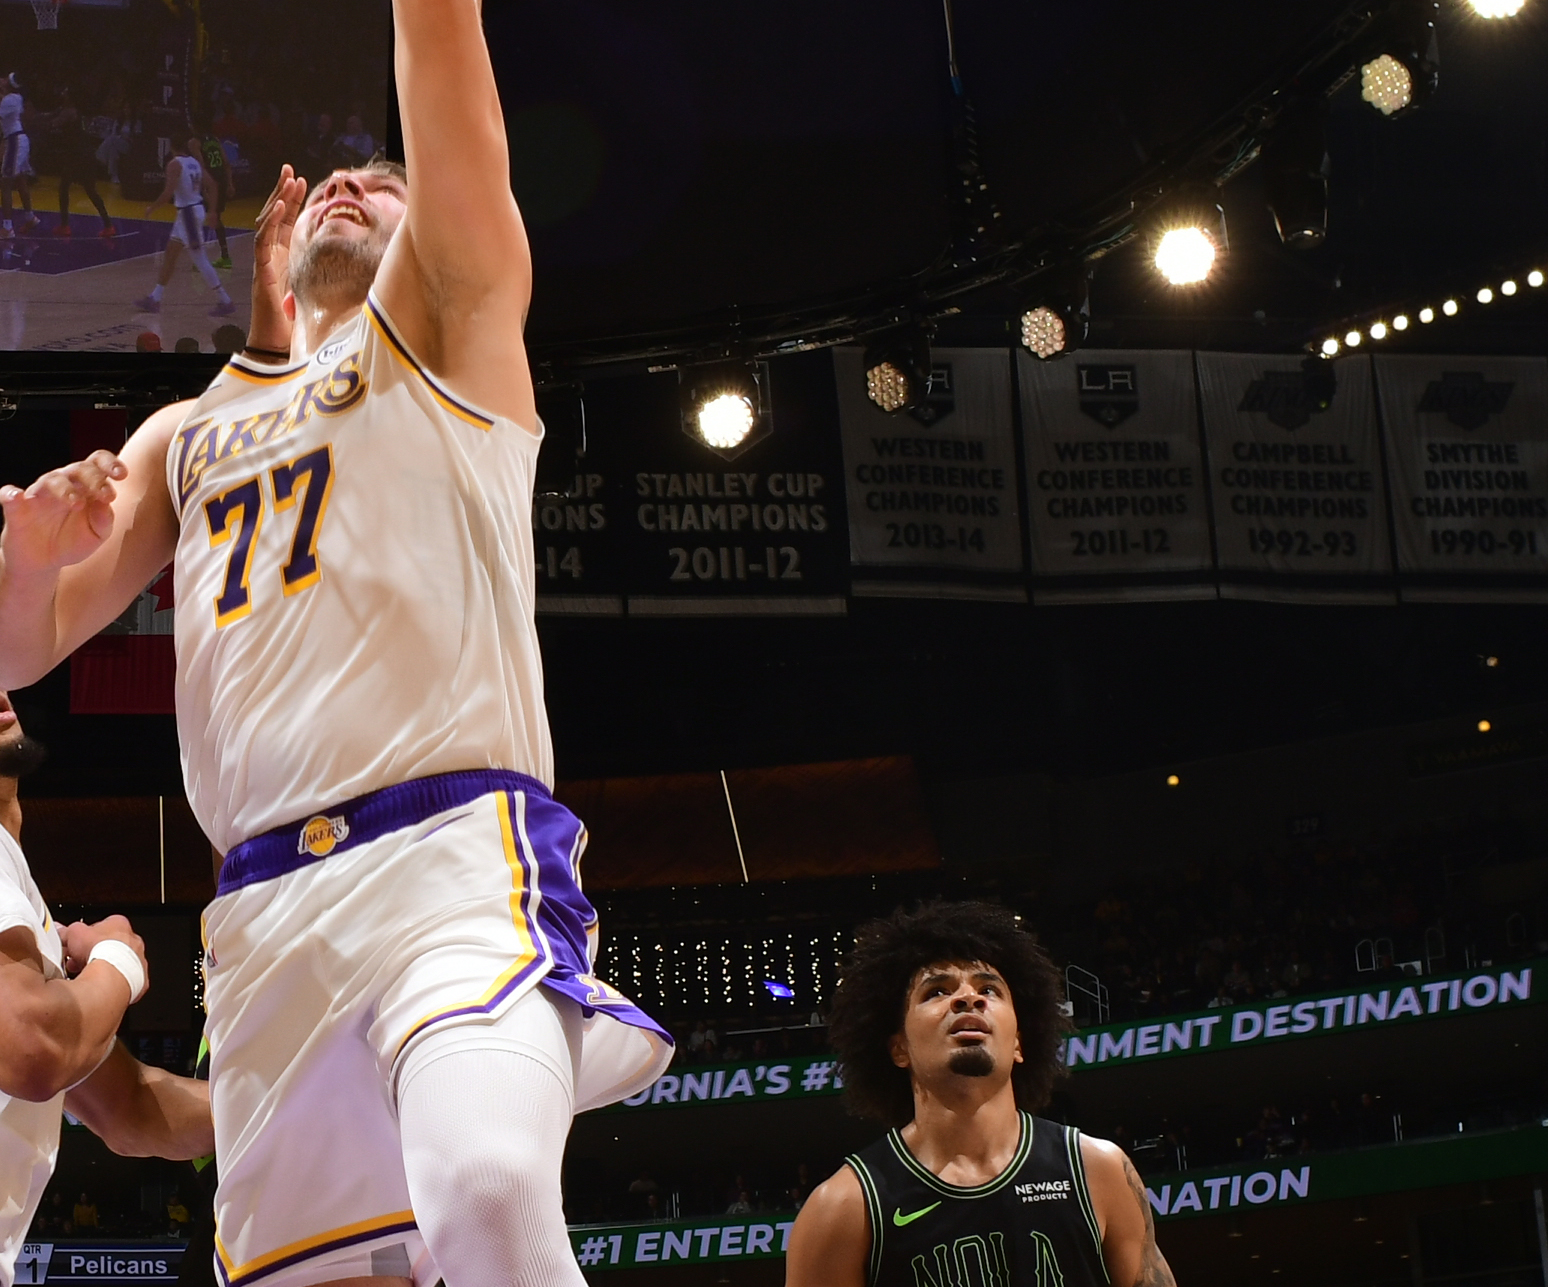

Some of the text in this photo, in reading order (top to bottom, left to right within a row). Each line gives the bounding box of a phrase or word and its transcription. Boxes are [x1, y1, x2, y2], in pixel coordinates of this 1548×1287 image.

[1081, 369, 1133, 391] LA
[176, 351, 369, 515] LAKERS
[873, 437, 984, 462] WESTERN
[1055, 440, 1170, 463] WESTERN
[1233, 442, 1355, 464] CAMPBELL
[1427, 442, 1518, 465] SMYTHE
[636, 473, 825, 499] STANLEY CUP
[856, 463, 1003, 490] CONFERENCE
[1038, 465, 1192, 491] CONFERENCE
[1222, 468, 1372, 492] CONFERENCE
[1425, 469, 1528, 492] DIVISION
[865, 490, 999, 517] CHAMPIONS
[1048, 493, 1187, 519] CHAMPIONS
[1231, 494, 1367, 519] CHAMPIONS
[1410, 495, 1548, 519] CHAMPIONS
[638, 504, 828, 533] CHAMPIONS
[204, 443, 335, 629] 77
[885, 523, 985, 553] 2013-14
[1070, 528, 1170, 558] 2011-12
[1248, 528, 1357, 557] 1992-93
[1431, 528, 1538, 557] 1990-91
[670, 546, 802, 582] 2011-12
[1231, 965, 1531, 1042] DESTINATION
[1014, 1181, 1072, 1197] NEWAGE
[1022, 1193, 1068, 1204] PRODUCTS
[24, 1244, 43, 1255] QTR
[577, 1229, 623, 1267] #1
[69, 1251, 169, 1277] Pelicans
